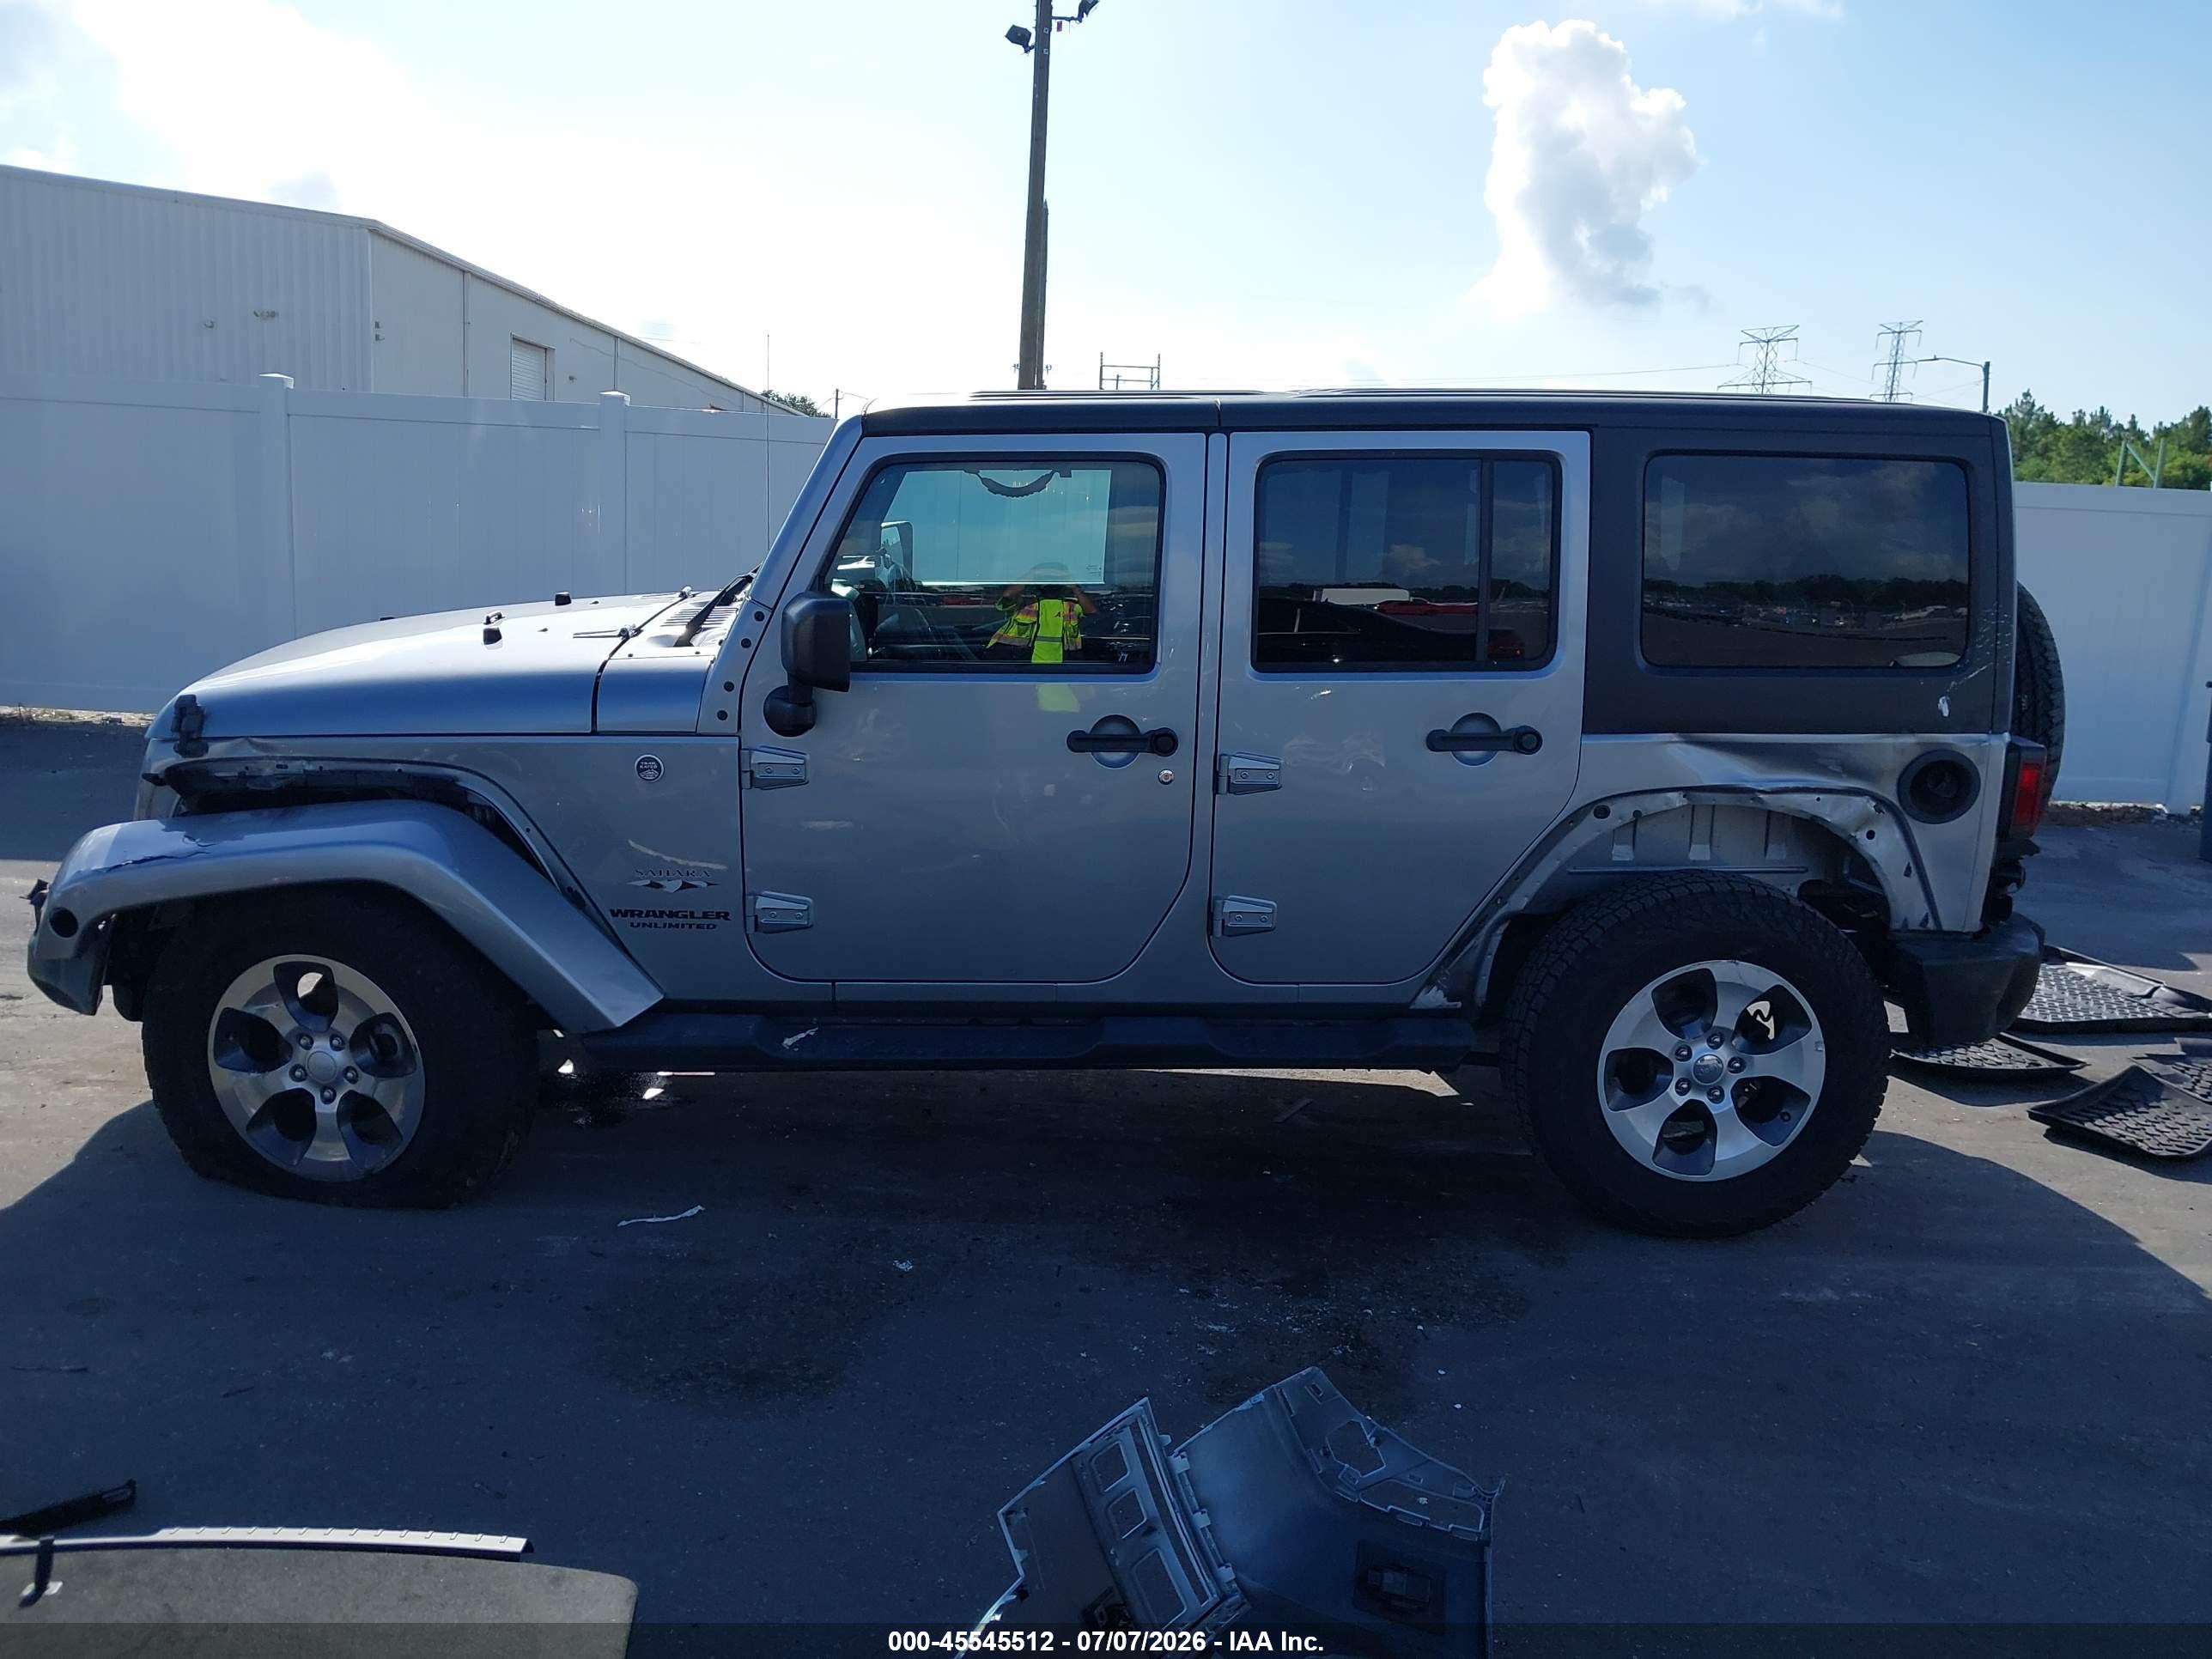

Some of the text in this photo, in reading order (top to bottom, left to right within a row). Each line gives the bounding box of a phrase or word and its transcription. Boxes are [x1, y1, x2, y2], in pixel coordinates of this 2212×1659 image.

[635, 868, 711, 878] SAHARA
[610, 908, 732, 921] WRANGLER
[630, 921, 717, 930] UNLIMITED
